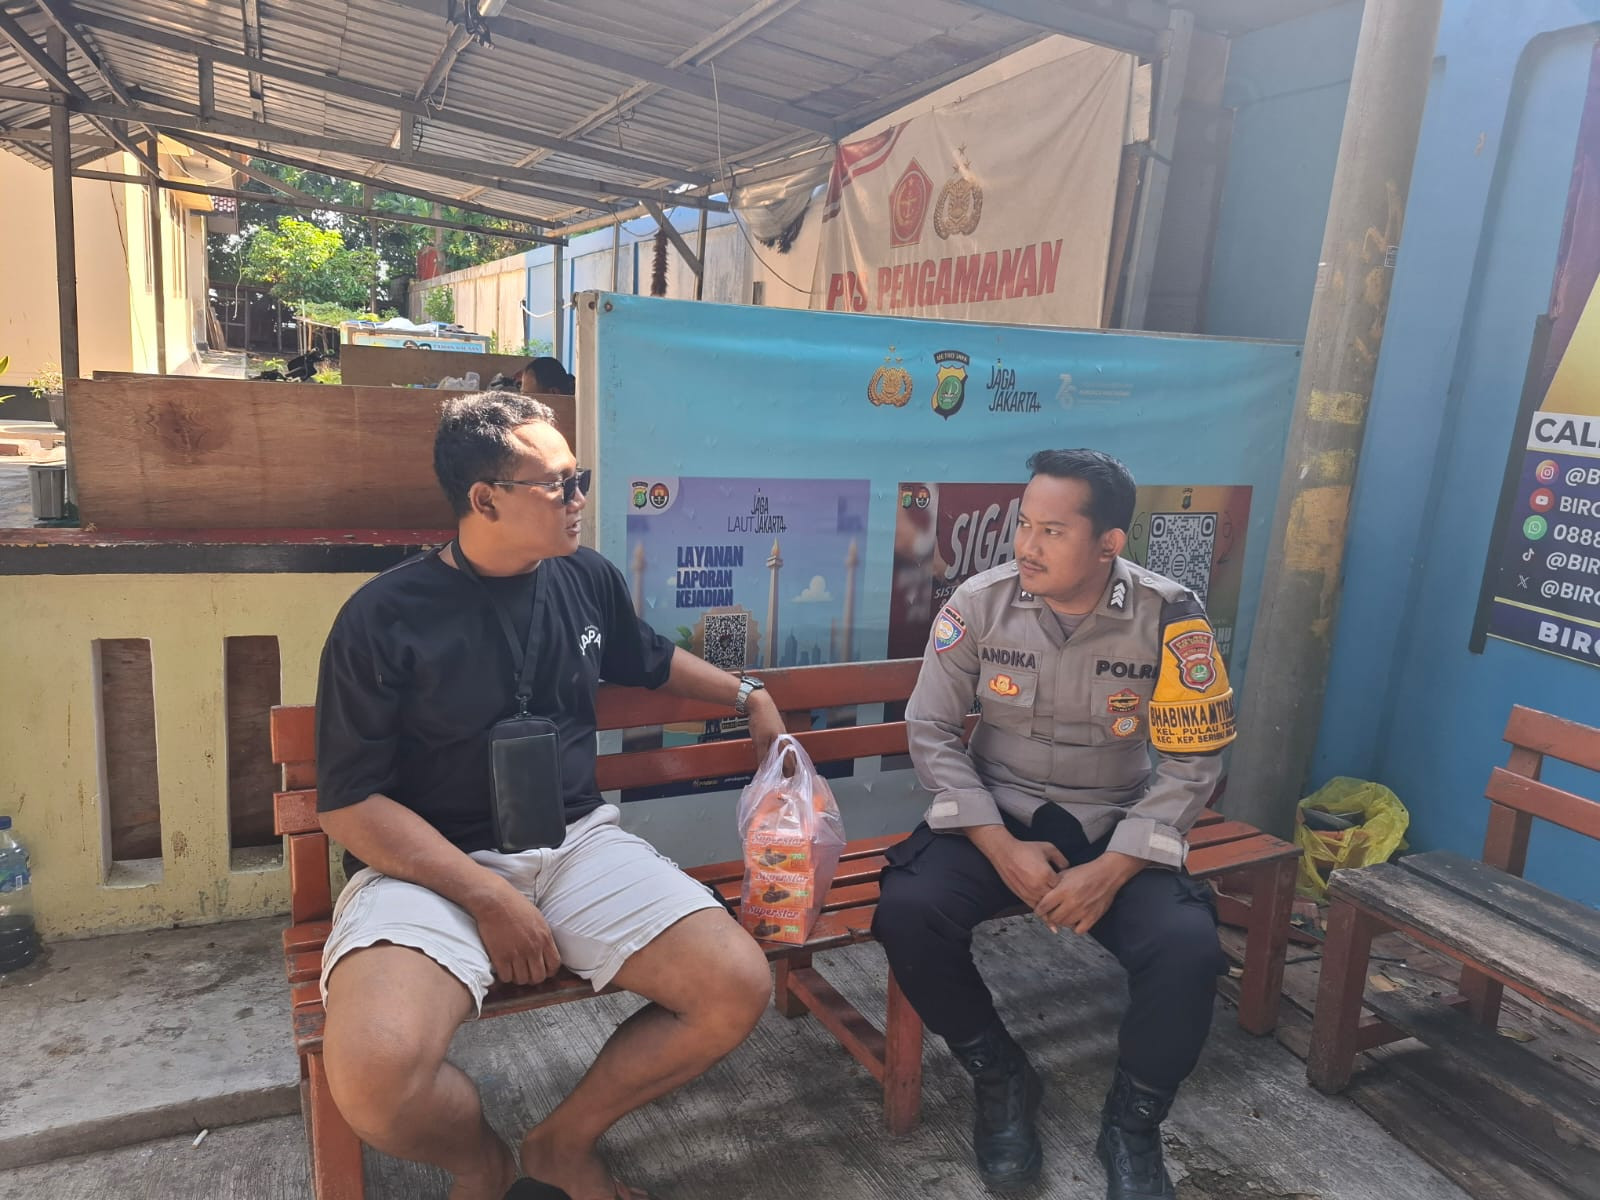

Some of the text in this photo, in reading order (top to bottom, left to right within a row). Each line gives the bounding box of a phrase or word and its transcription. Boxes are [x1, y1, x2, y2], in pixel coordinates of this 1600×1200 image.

[826, 239, 1064, 312] POS PENGAMANAN
[986, 365, 1016, 390] JAGA
[1535, 418, 1600, 449] CAL
[750, 495, 769, 515] JAGA
[728, 516, 754, 533] LAUT
[677, 546, 744, 568] LAYANAN
[676, 570, 732, 588] LAPORAN
[676, 589, 733, 608] KEJADIAN
[981, 646, 1037, 669] ANDIKA
[1182, 724, 1218, 735] PULAU
[755, 871, 809, 884] Superstar
[747, 904, 799, 919] Superstar
